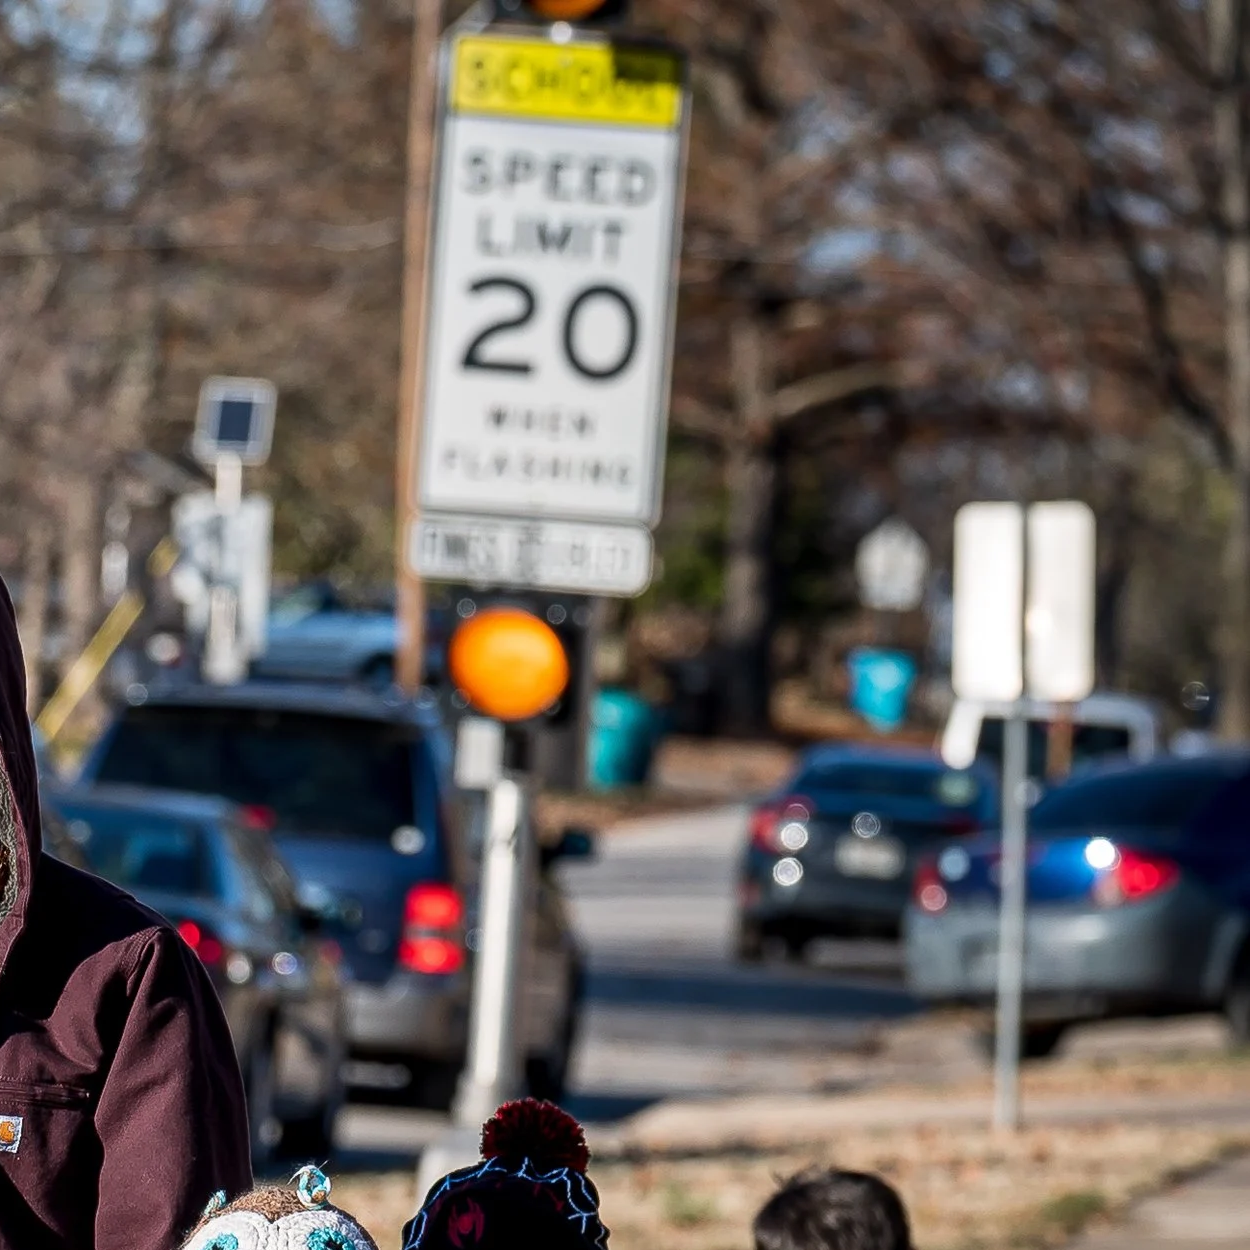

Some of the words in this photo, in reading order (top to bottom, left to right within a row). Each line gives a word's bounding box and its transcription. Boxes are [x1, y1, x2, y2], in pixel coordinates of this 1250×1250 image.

[463, 148, 654, 206] SPEED
[477, 213, 626, 263] LIMIT
[461, 277, 639, 379] 20
[485, 405, 597, 440] WHEN
